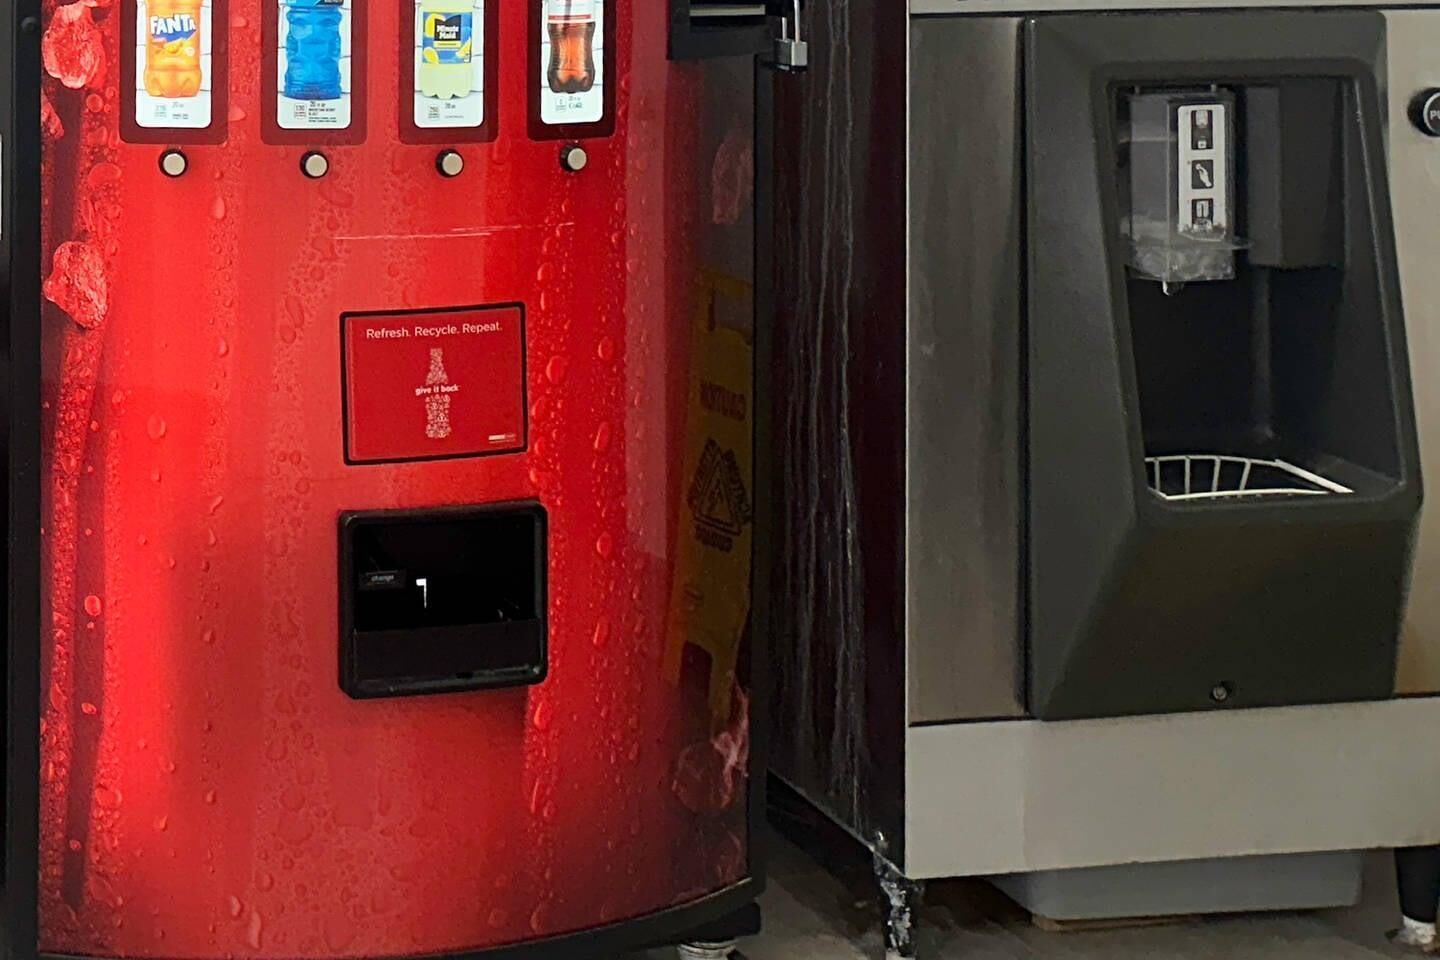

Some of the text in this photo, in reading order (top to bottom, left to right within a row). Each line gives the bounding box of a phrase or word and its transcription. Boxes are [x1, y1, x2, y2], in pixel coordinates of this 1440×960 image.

[366, 321, 503, 339] Refresh. Recycle. Repeat.
